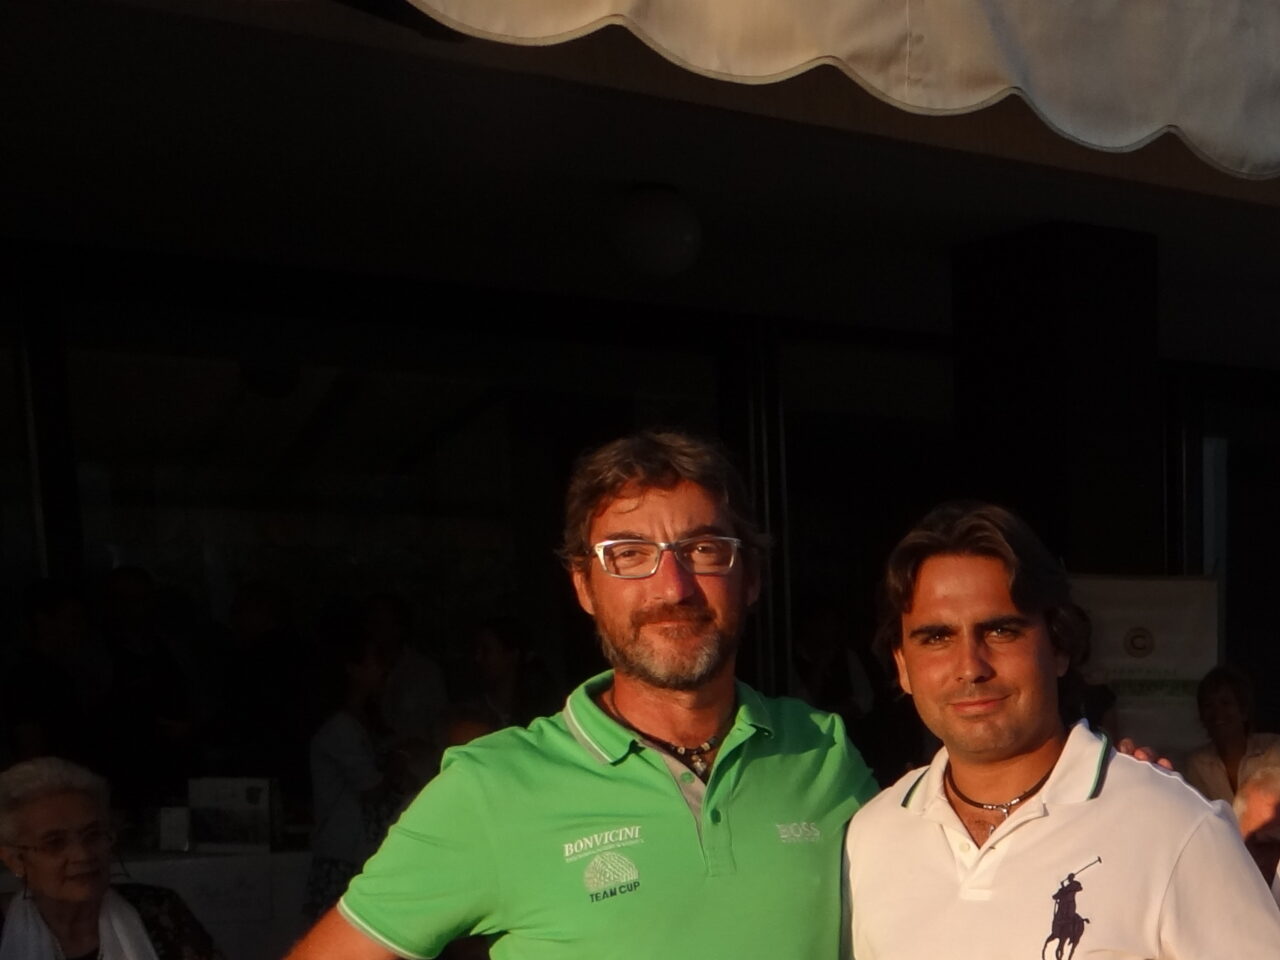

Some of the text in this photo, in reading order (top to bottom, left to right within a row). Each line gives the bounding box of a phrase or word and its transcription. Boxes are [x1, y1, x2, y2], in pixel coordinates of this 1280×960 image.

[564, 826, 642, 857] BONVICINI
[589, 881, 641, 903] TEAM CUP
